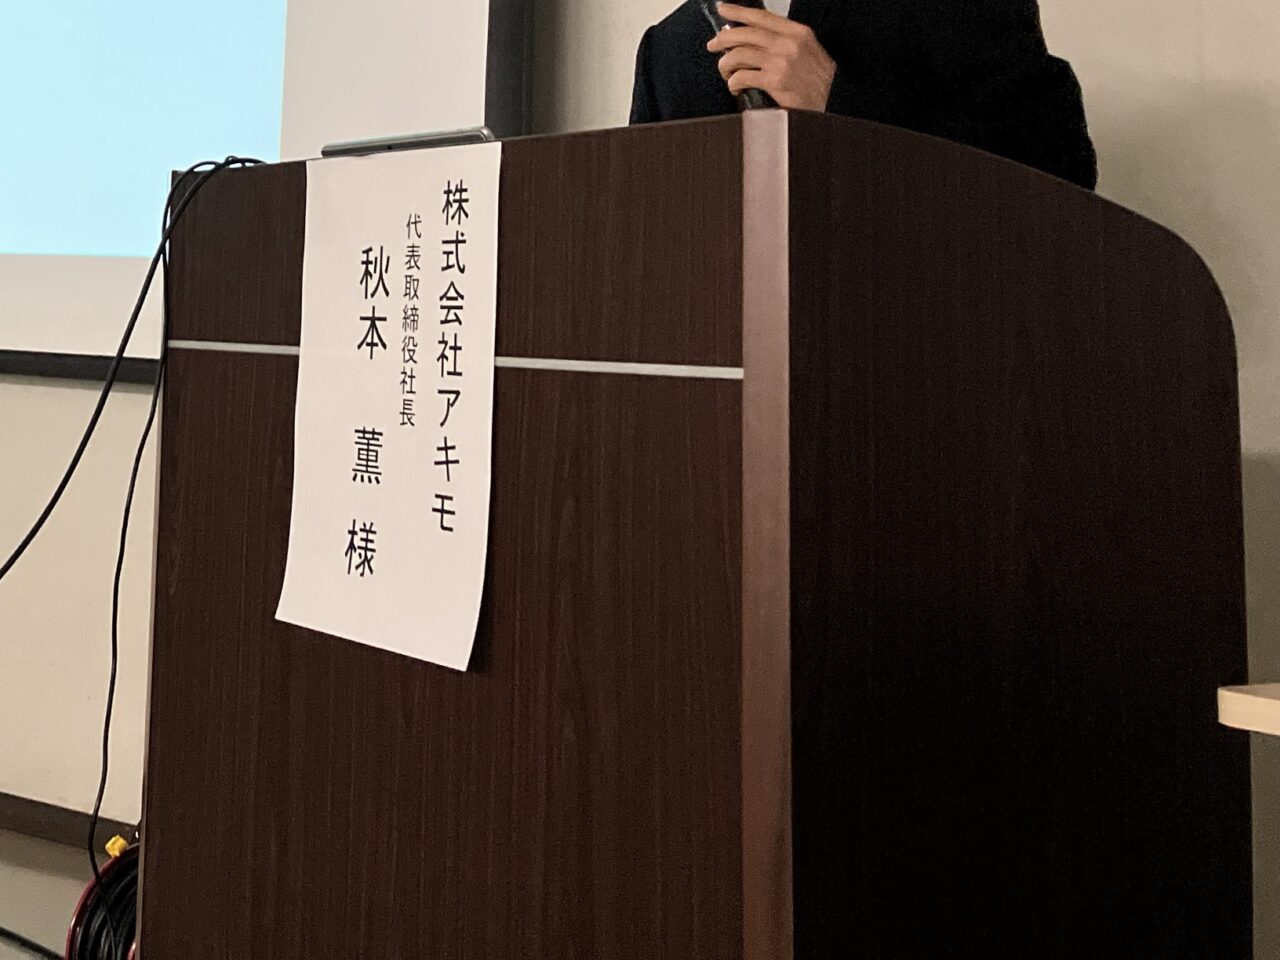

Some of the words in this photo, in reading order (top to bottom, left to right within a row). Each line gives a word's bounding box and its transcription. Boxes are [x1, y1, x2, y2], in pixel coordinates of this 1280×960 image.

[357, 245, 391, 360] 秋本
[399, 213, 422, 427] 代表取締役社長
[431, 179, 470, 533] 株式会社アキモ
[344, 518, 377, 577] 様
